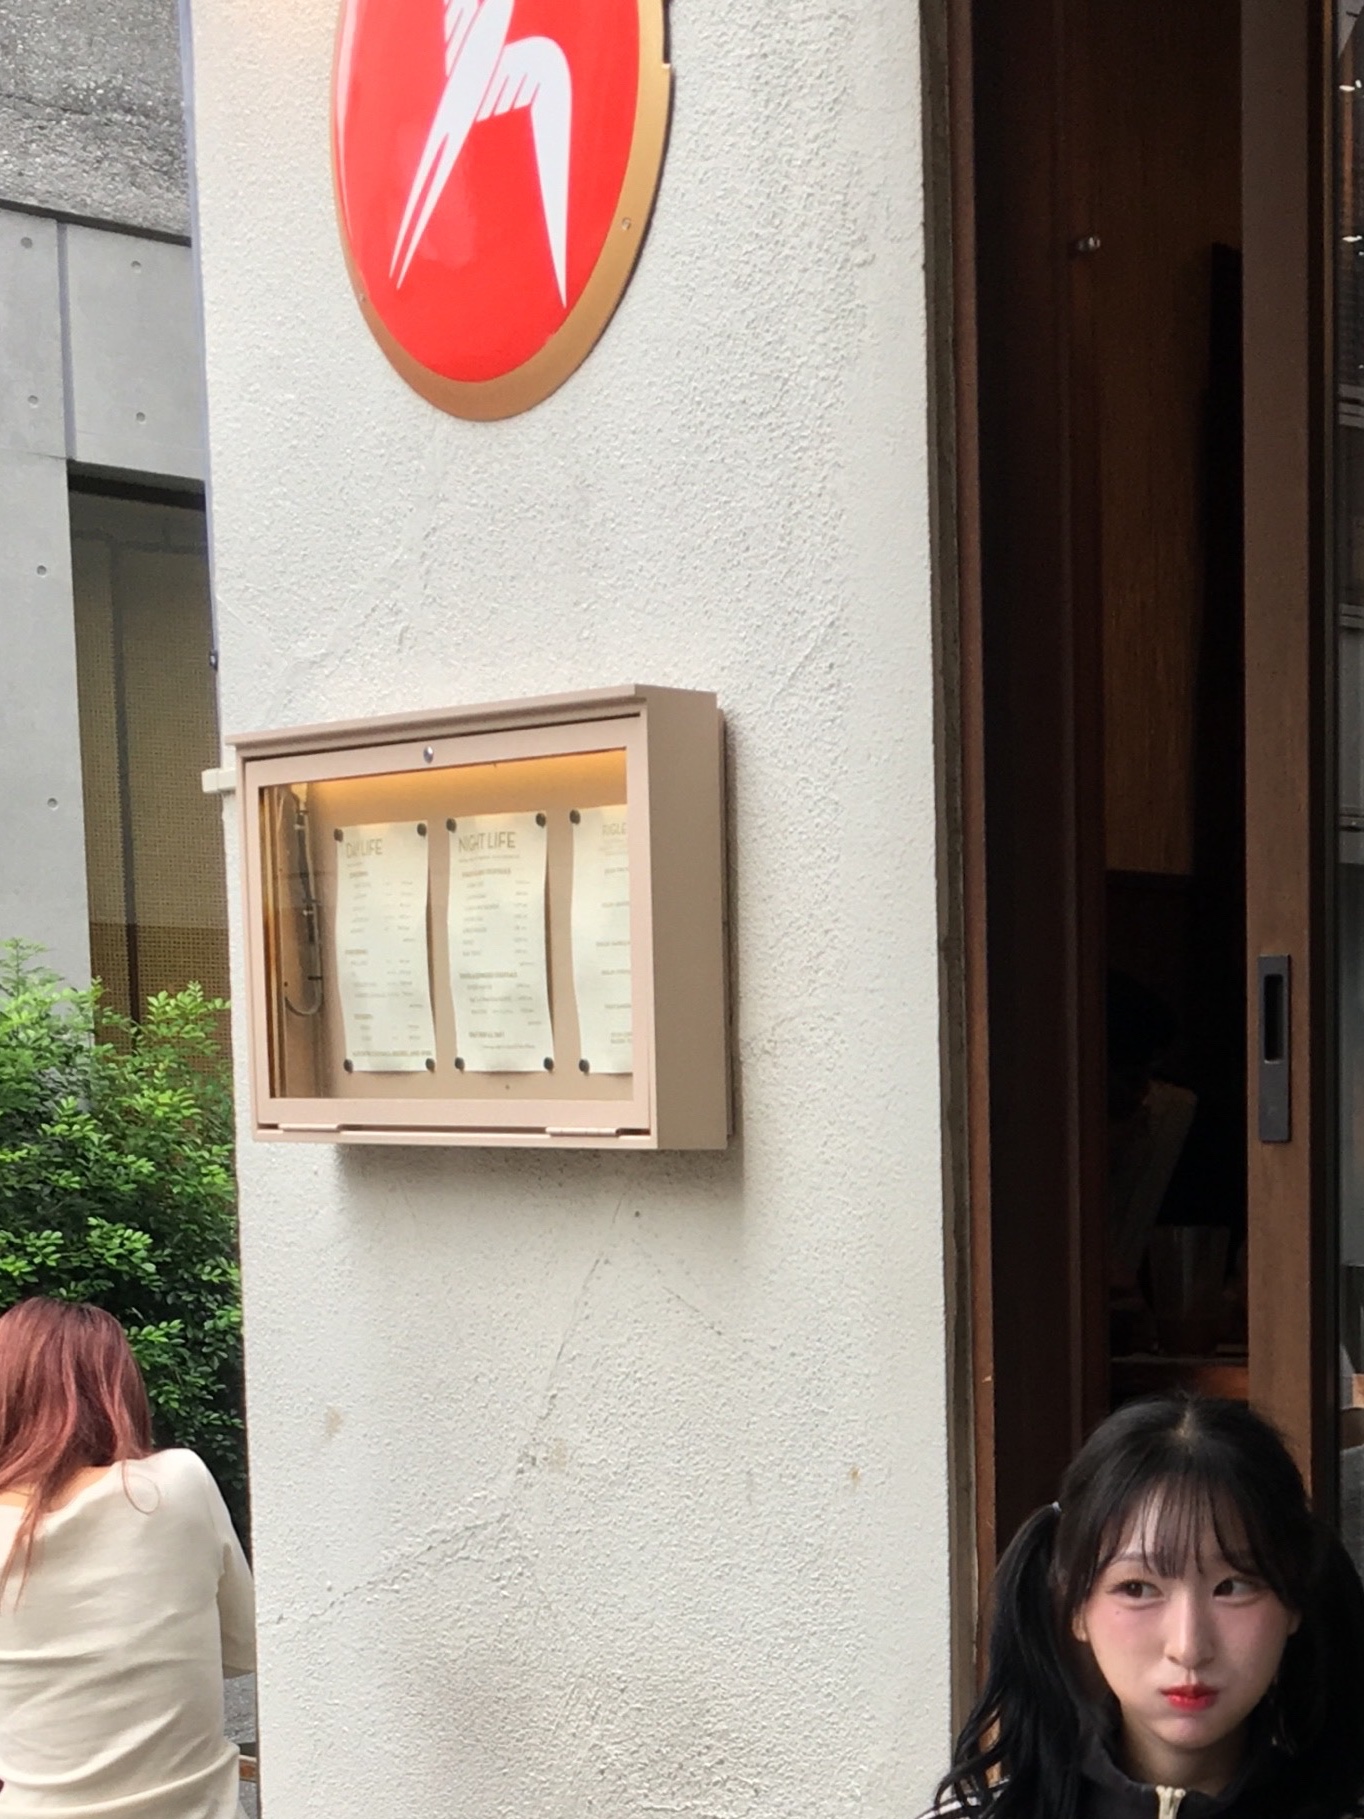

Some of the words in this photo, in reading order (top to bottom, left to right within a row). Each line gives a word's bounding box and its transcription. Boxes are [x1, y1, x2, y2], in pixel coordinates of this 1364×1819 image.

[361, 838, 383, 856] LIFE
[458, 832, 486, 853] NIGHT
[487, 831, 516, 849] LIFE
